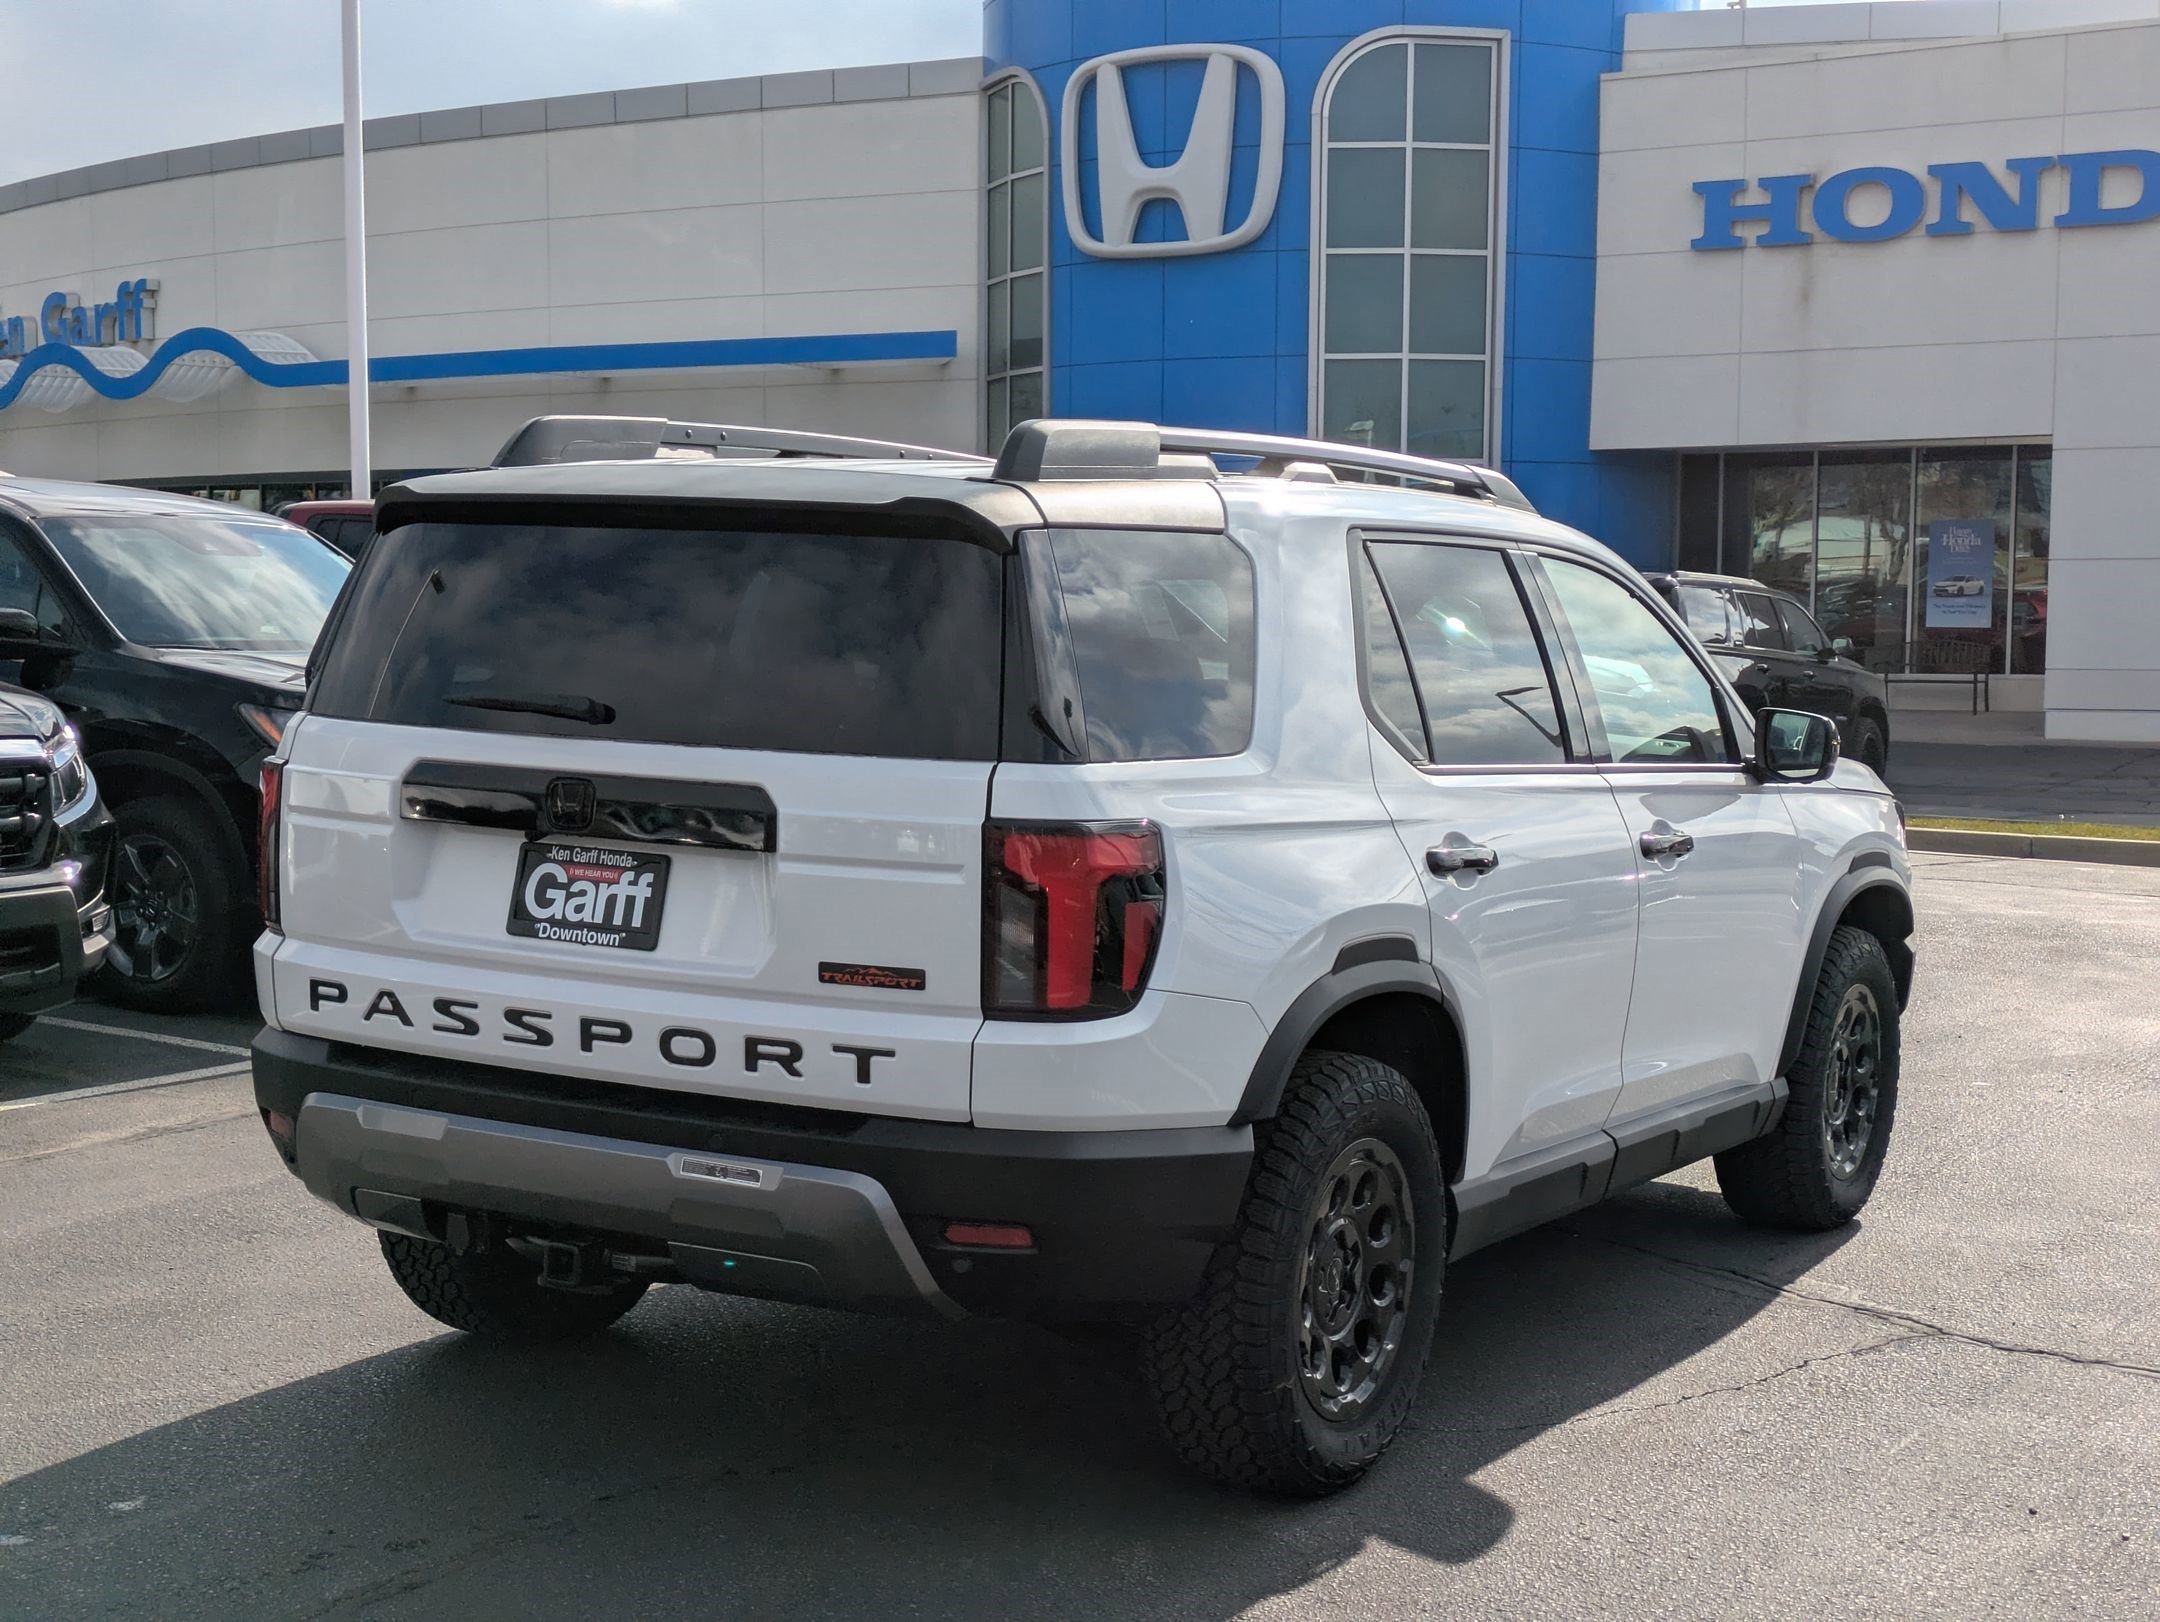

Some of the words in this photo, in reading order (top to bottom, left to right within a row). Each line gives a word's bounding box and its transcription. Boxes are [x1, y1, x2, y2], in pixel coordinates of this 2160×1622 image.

[0, 314, 35, 356] en
[41, 278, 159, 346] Garff
[1942, 533, 1981, 546] Honda
[551, 845, 570, 861] Ken
[572, 847, 599, 864] Garff
[599, 850, 633, 868] Honda
[574, 868, 585, 876] WE
[585, 869, 601, 878] HEAR
[602, 871, 614, 879] YOU
[525, 862, 654, 928] Garff
[538, 922, 620, 946] Downtown
[821, 971, 921, 989] TRAILSPORT
[309, 978, 897, 1085] PASSPORT
